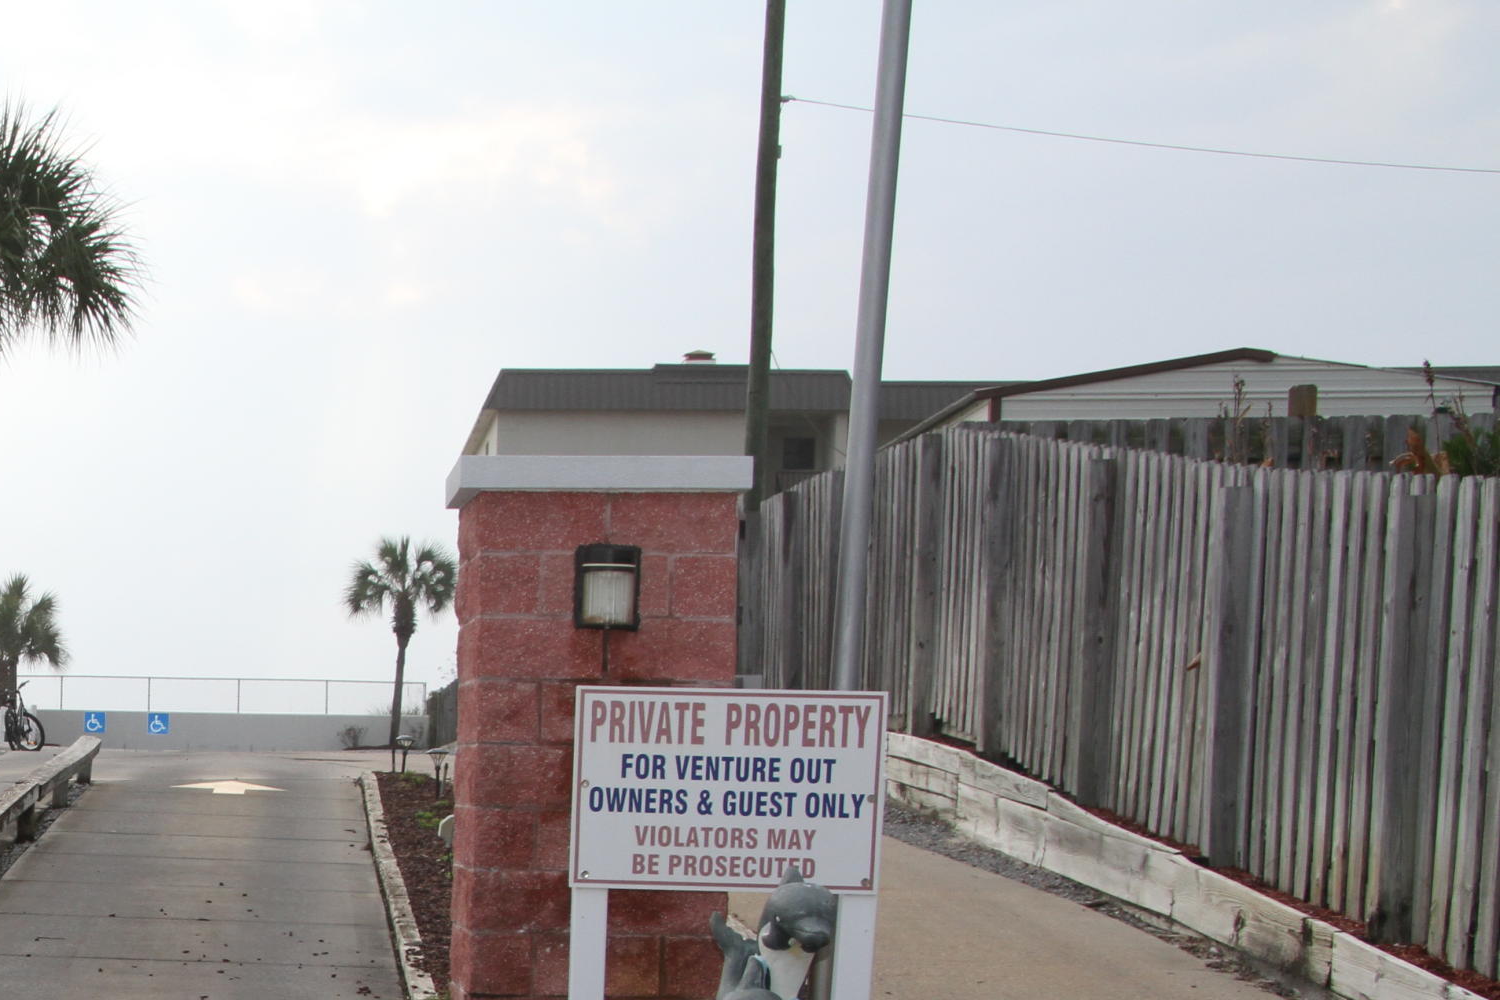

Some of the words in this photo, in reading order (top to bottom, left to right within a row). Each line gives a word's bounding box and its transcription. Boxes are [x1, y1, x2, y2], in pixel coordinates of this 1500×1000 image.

[590, 700, 706, 745] PRIVATE
[725, 703, 871, 748] PROPERTY
[621, 754, 666, 780] FOR
[675, 755, 781, 782] VENTURE
[790, 758, 836, 784] OUT
[589, 786, 688, 815] OWNERS
[697, 790, 713, 815] &
[722, 791, 796, 817] GUEST
[805, 793, 865, 818] ONLY
[635, 825, 758, 850] VIOLATORS
[767, 829, 816, 850] MAY
[632, 853, 660, 875] BE
